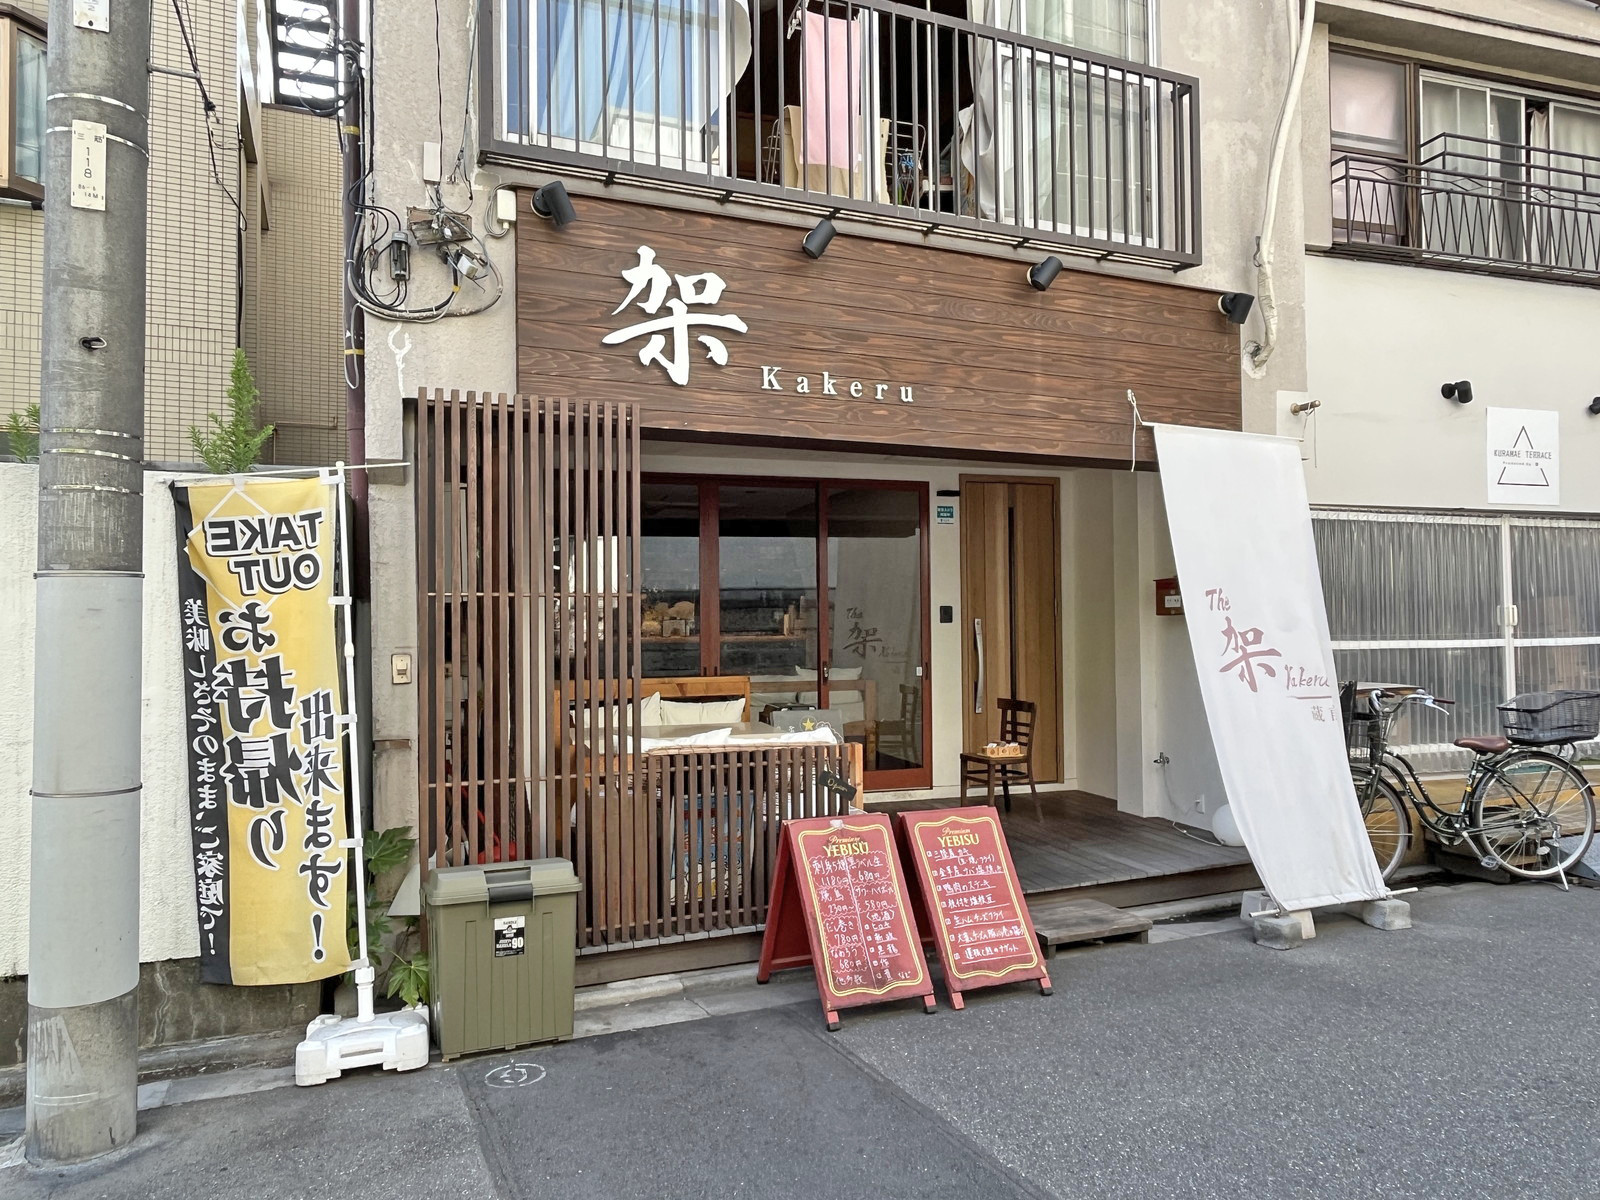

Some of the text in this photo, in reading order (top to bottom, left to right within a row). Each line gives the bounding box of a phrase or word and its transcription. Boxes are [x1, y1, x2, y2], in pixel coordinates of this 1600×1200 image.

[601, 245, 748, 386] 架
[760, 365, 914, 403] Kakeru
[1494, 450, 1552, 459] KURAMAE TERRACE
[1205, 588, 1231, 611] The
[1219, 616, 1282, 693] 架
[937, 833, 980, 848] YEBISU
[941, 826, 971, 836] Premium
[822, 841, 869, 857] YEBISU
